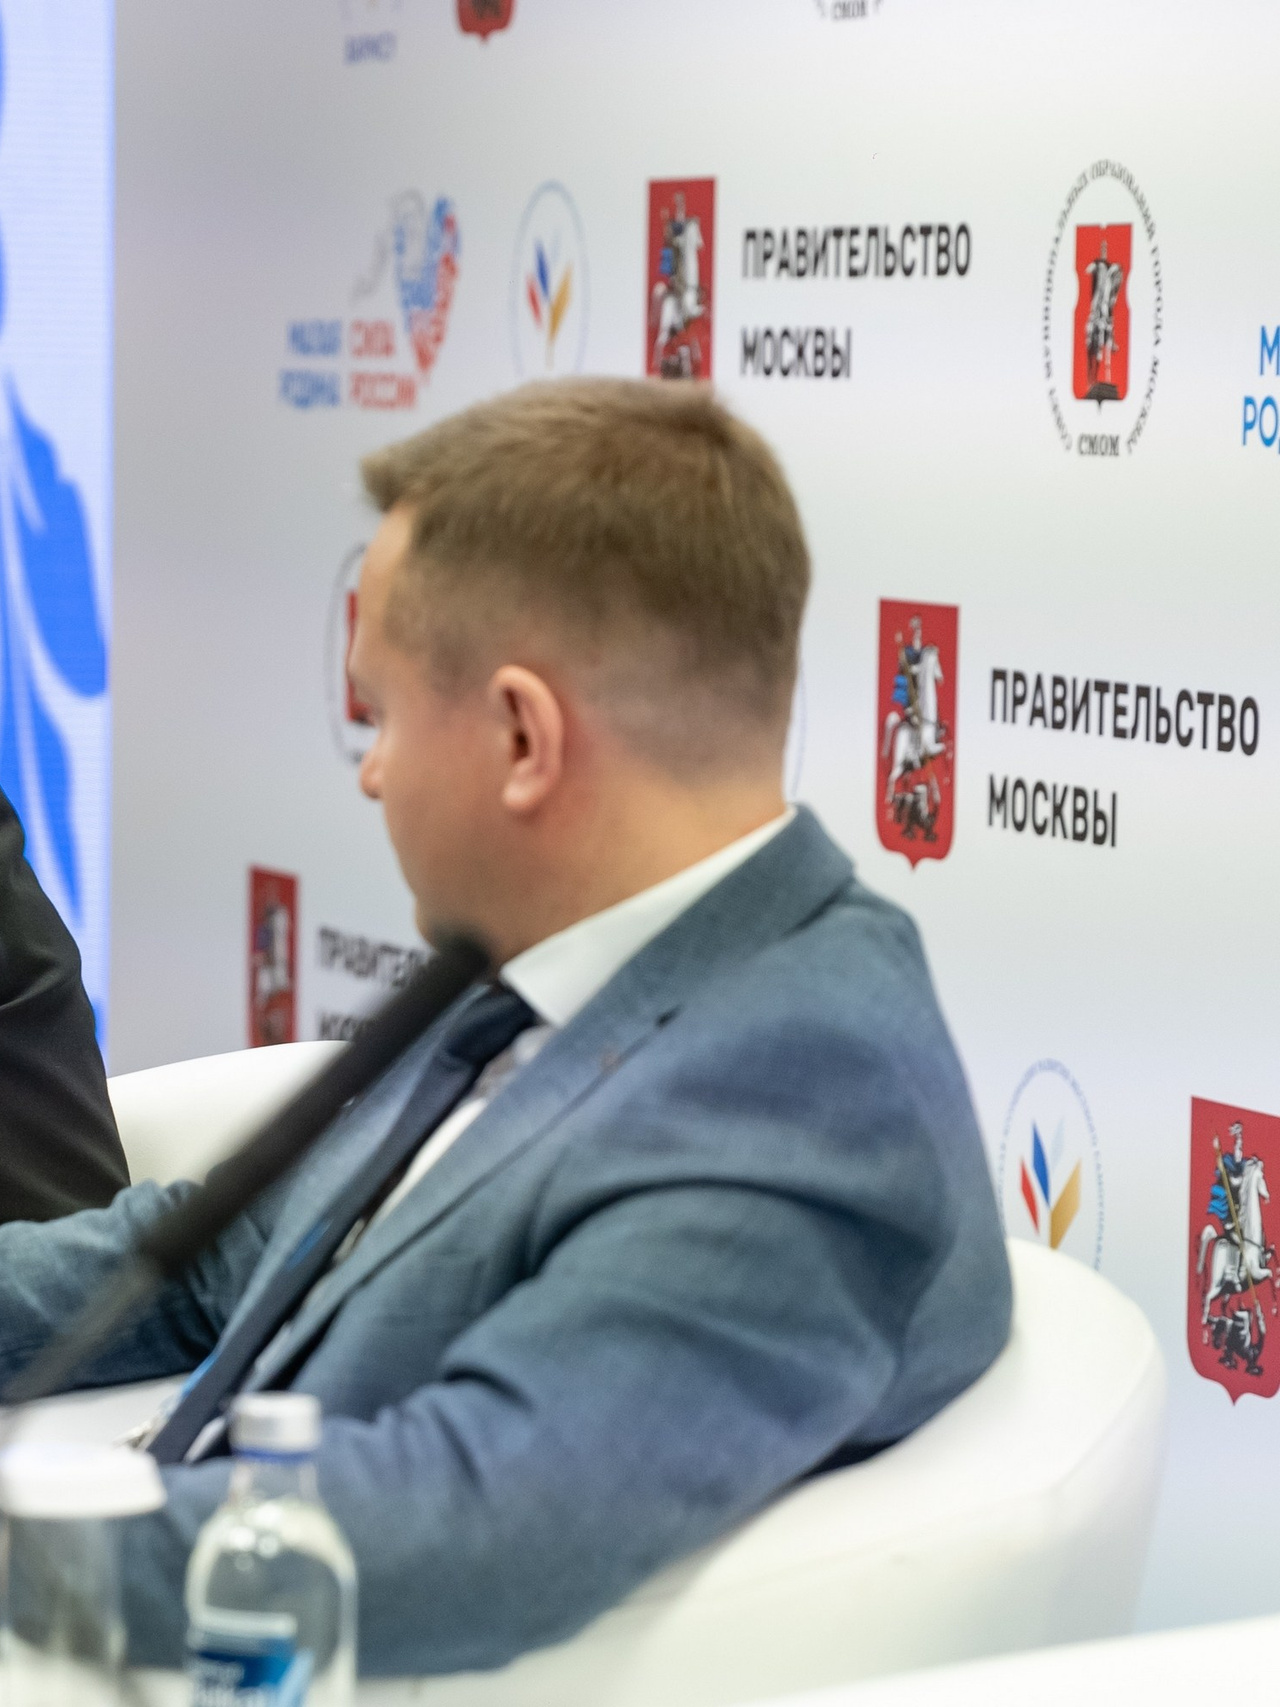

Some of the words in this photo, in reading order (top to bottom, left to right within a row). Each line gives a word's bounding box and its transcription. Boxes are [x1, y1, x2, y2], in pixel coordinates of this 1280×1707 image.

[742, 222, 972, 279] ПРАВИТЕЛЬСТВО
[740, 327, 852, 379] МОСКВЫ
[1078, 433, 1120, 456] СМОМ
[1242, 395, 1280, 455] РО
[990, 667, 1260, 756] ПРАВИТЕЛЬСТВО
[988, 773, 1117, 848] МОСКВЫ
